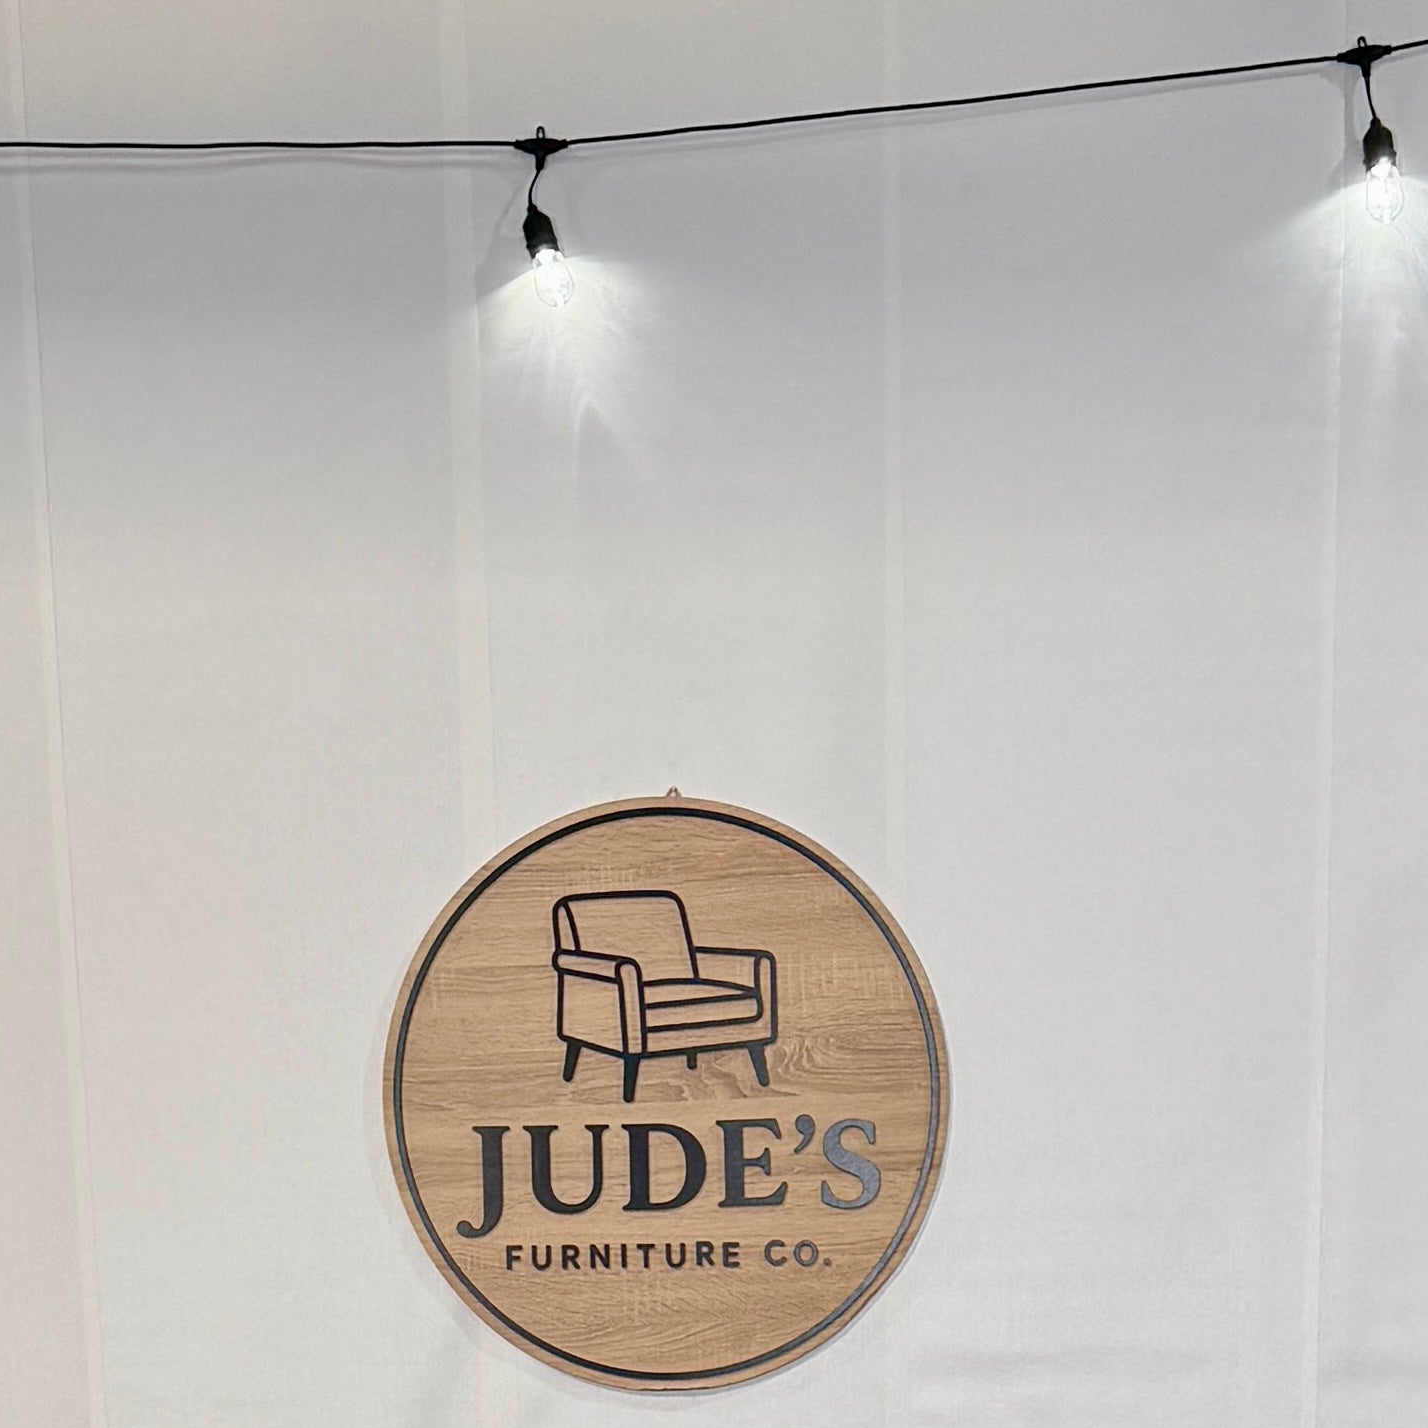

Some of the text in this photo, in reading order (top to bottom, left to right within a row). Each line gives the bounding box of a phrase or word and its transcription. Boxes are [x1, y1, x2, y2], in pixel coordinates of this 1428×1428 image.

[456, 1114, 882, 1239] JUDE’S
[505, 1238, 832, 1272] FURNITURE CO.
